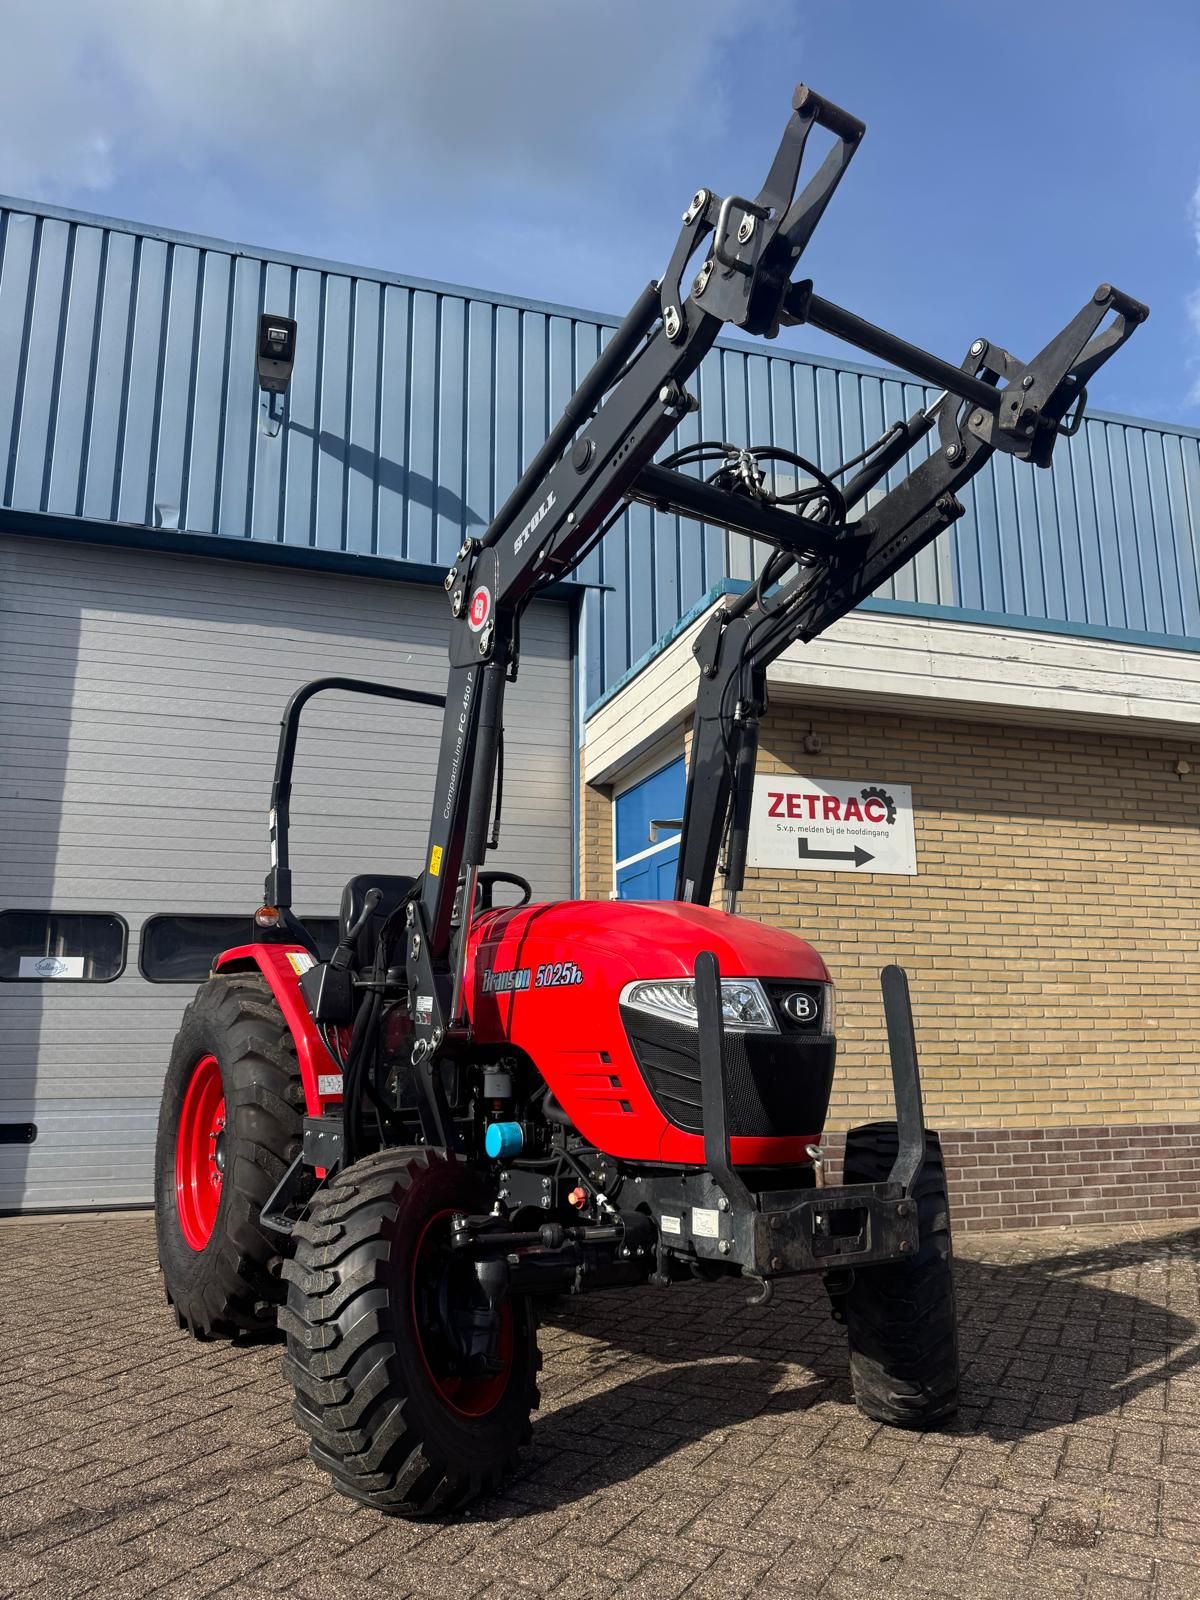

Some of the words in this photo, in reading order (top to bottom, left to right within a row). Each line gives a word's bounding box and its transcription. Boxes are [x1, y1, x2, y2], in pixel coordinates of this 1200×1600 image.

[514, 490, 556, 556] STOLL
[443, 737, 463, 820] CompactLine
[458, 715, 466, 733] FC
[463, 685, 471, 710] 450
[467, 671, 473, 682] P
[767, 792, 886, 823] ZETRAC
[776, 824, 796, 833] S.v.p.
[797, 825, 824, 834] melden
[826, 826, 835, 836] bij
[836, 827, 845, 835] de
[846, 827, 890, 839] hoofdingang
[482, 968, 531, 992] Branson
[535, 962, 582, 987] 5025h
[796, 997, 810, 1017] B
